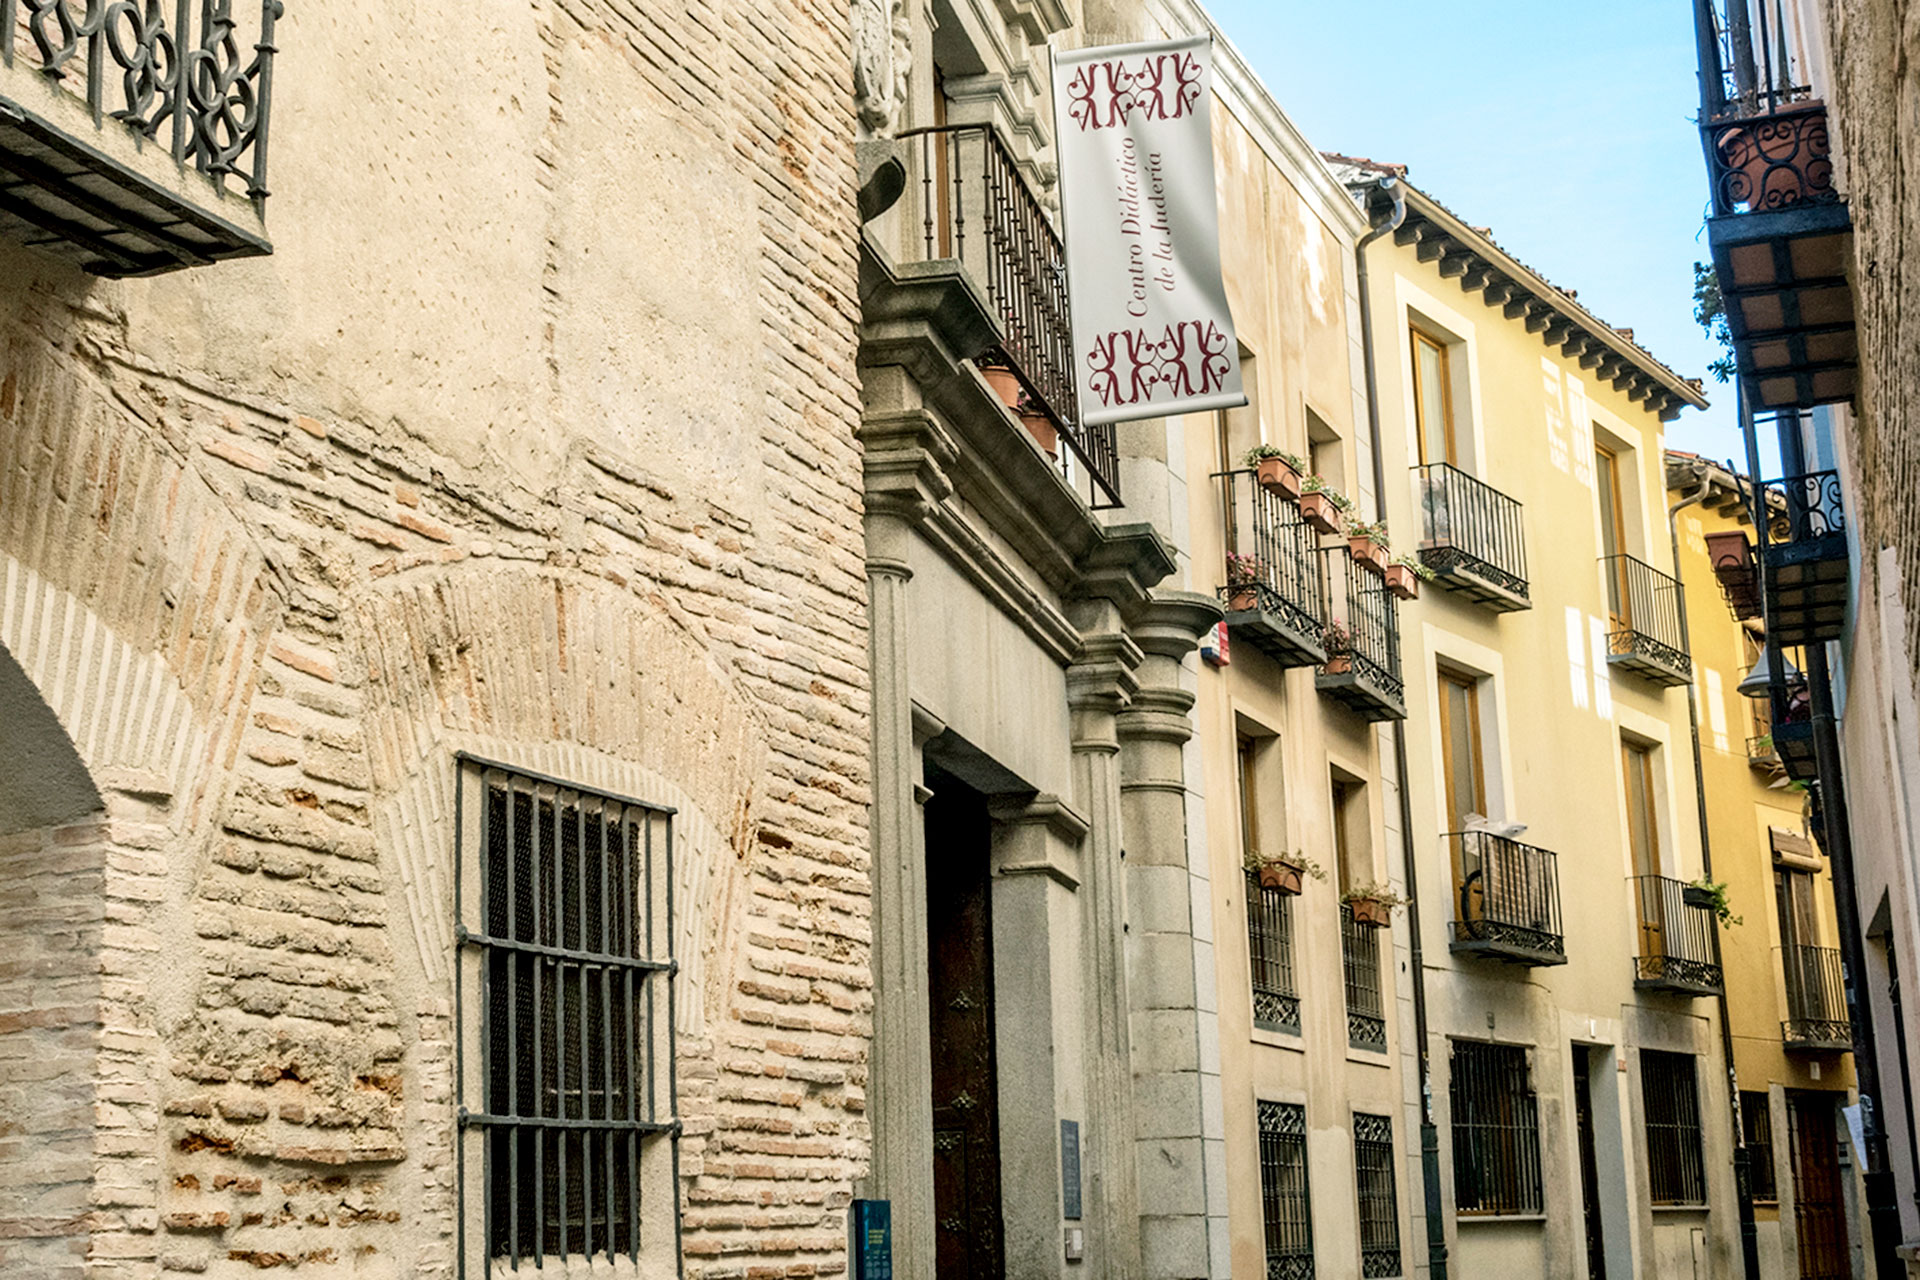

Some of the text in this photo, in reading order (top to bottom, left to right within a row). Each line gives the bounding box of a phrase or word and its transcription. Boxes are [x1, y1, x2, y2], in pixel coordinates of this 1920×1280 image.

[1116, 136, 1148, 318] Centro Didáctico
[1144, 151, 1175, 292] de la Judería
